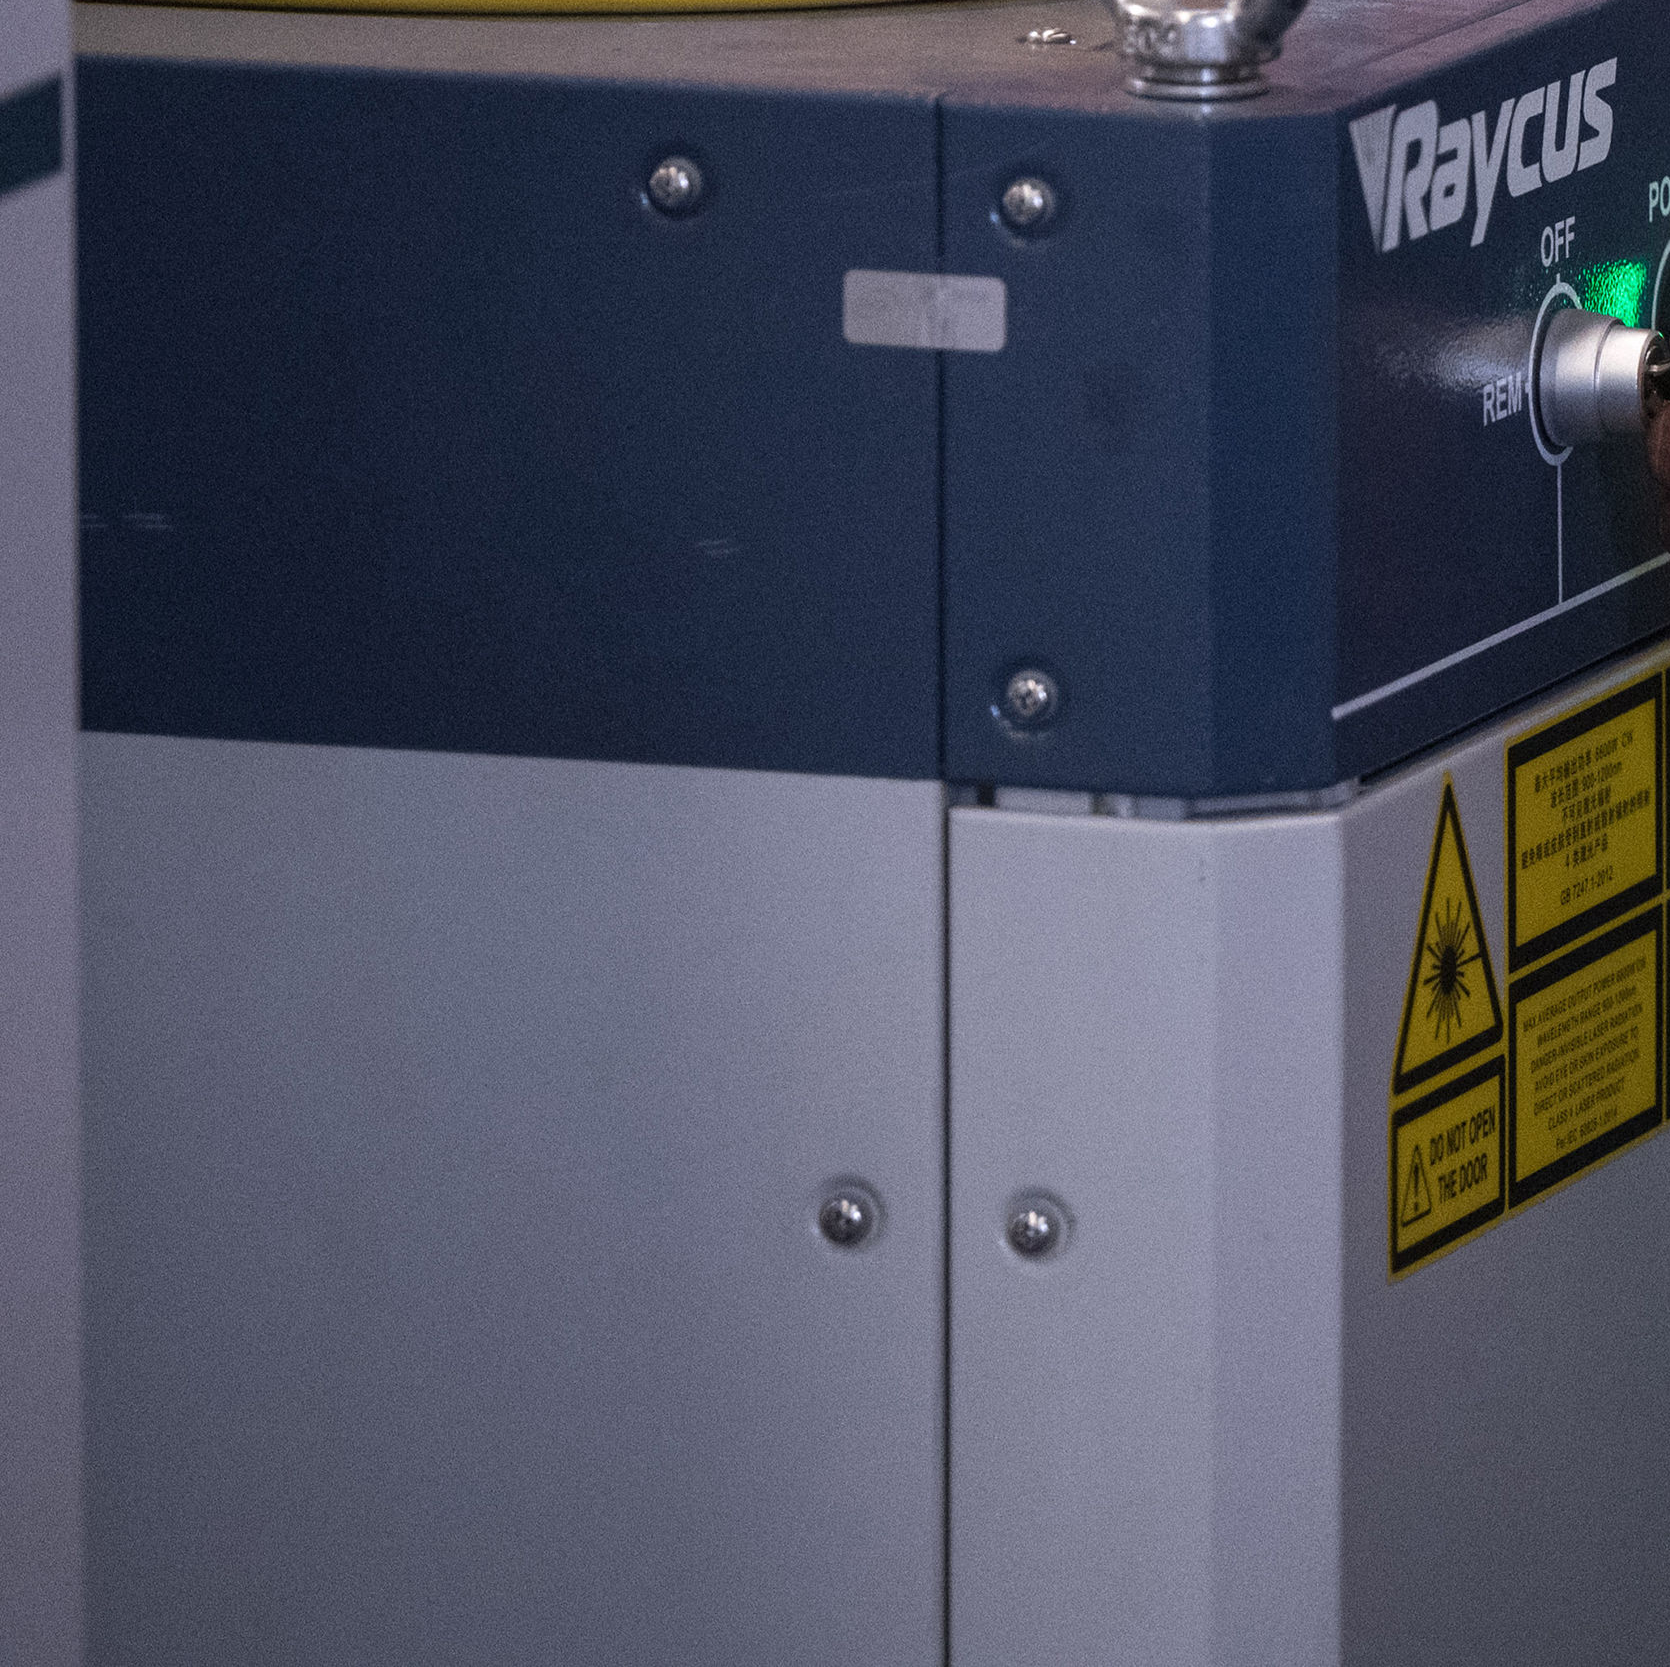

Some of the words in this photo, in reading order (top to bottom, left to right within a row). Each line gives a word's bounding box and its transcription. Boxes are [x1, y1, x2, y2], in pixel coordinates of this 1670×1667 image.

[1349, 57, 1617, 254] Raycus
[1541, 216, 1575, 267] OFF
[1483, 371, 1522, 427] REM
[1430, 1134, 1443, 1165] DO
[1447, 1122, 1466, 1156] NOT
[1469, 1107, 1495, 1145] OPEN
[1438, 1170, 1456, 1204] THE
[1459, 1154, 1487, 1192] DOOR
